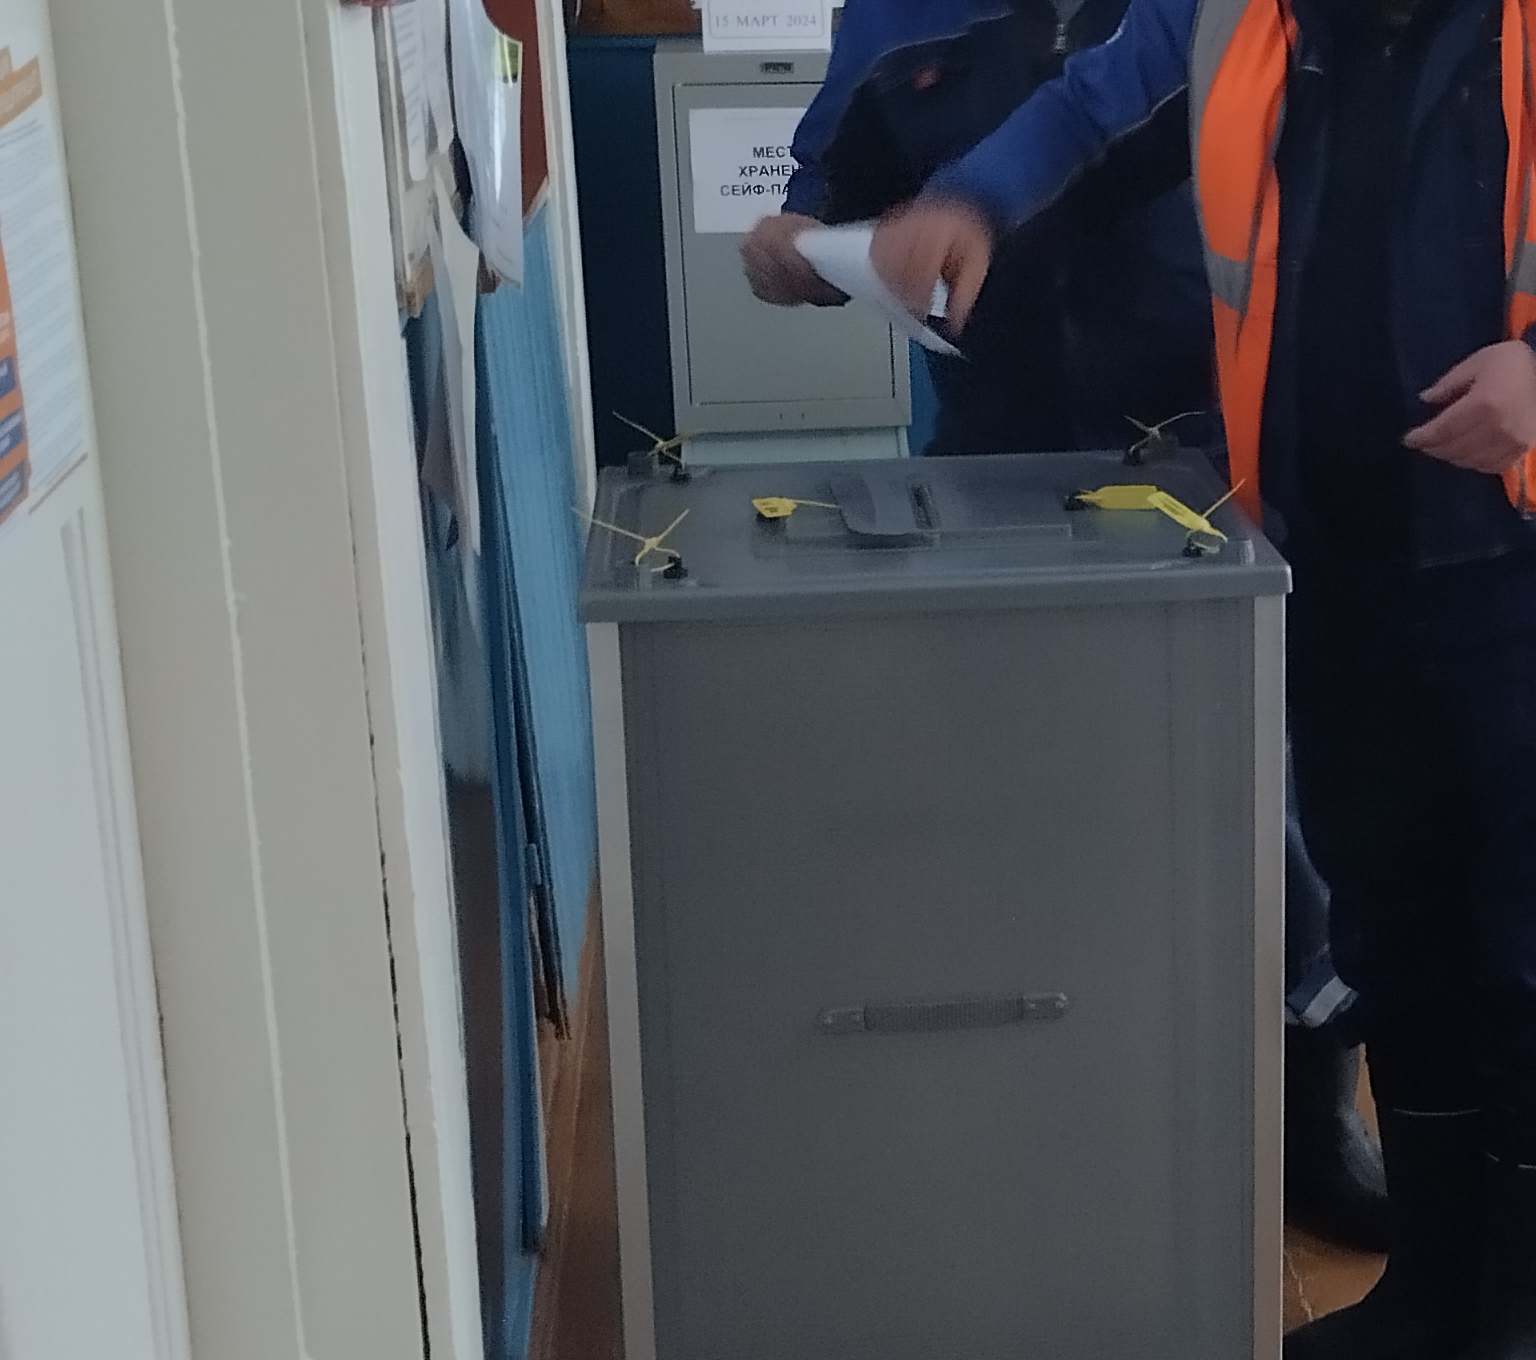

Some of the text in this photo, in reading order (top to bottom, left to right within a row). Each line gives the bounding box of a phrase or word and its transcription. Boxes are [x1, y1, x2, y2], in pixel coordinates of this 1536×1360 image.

[714, 14, 817, 28] 15 МАРТ 2024
